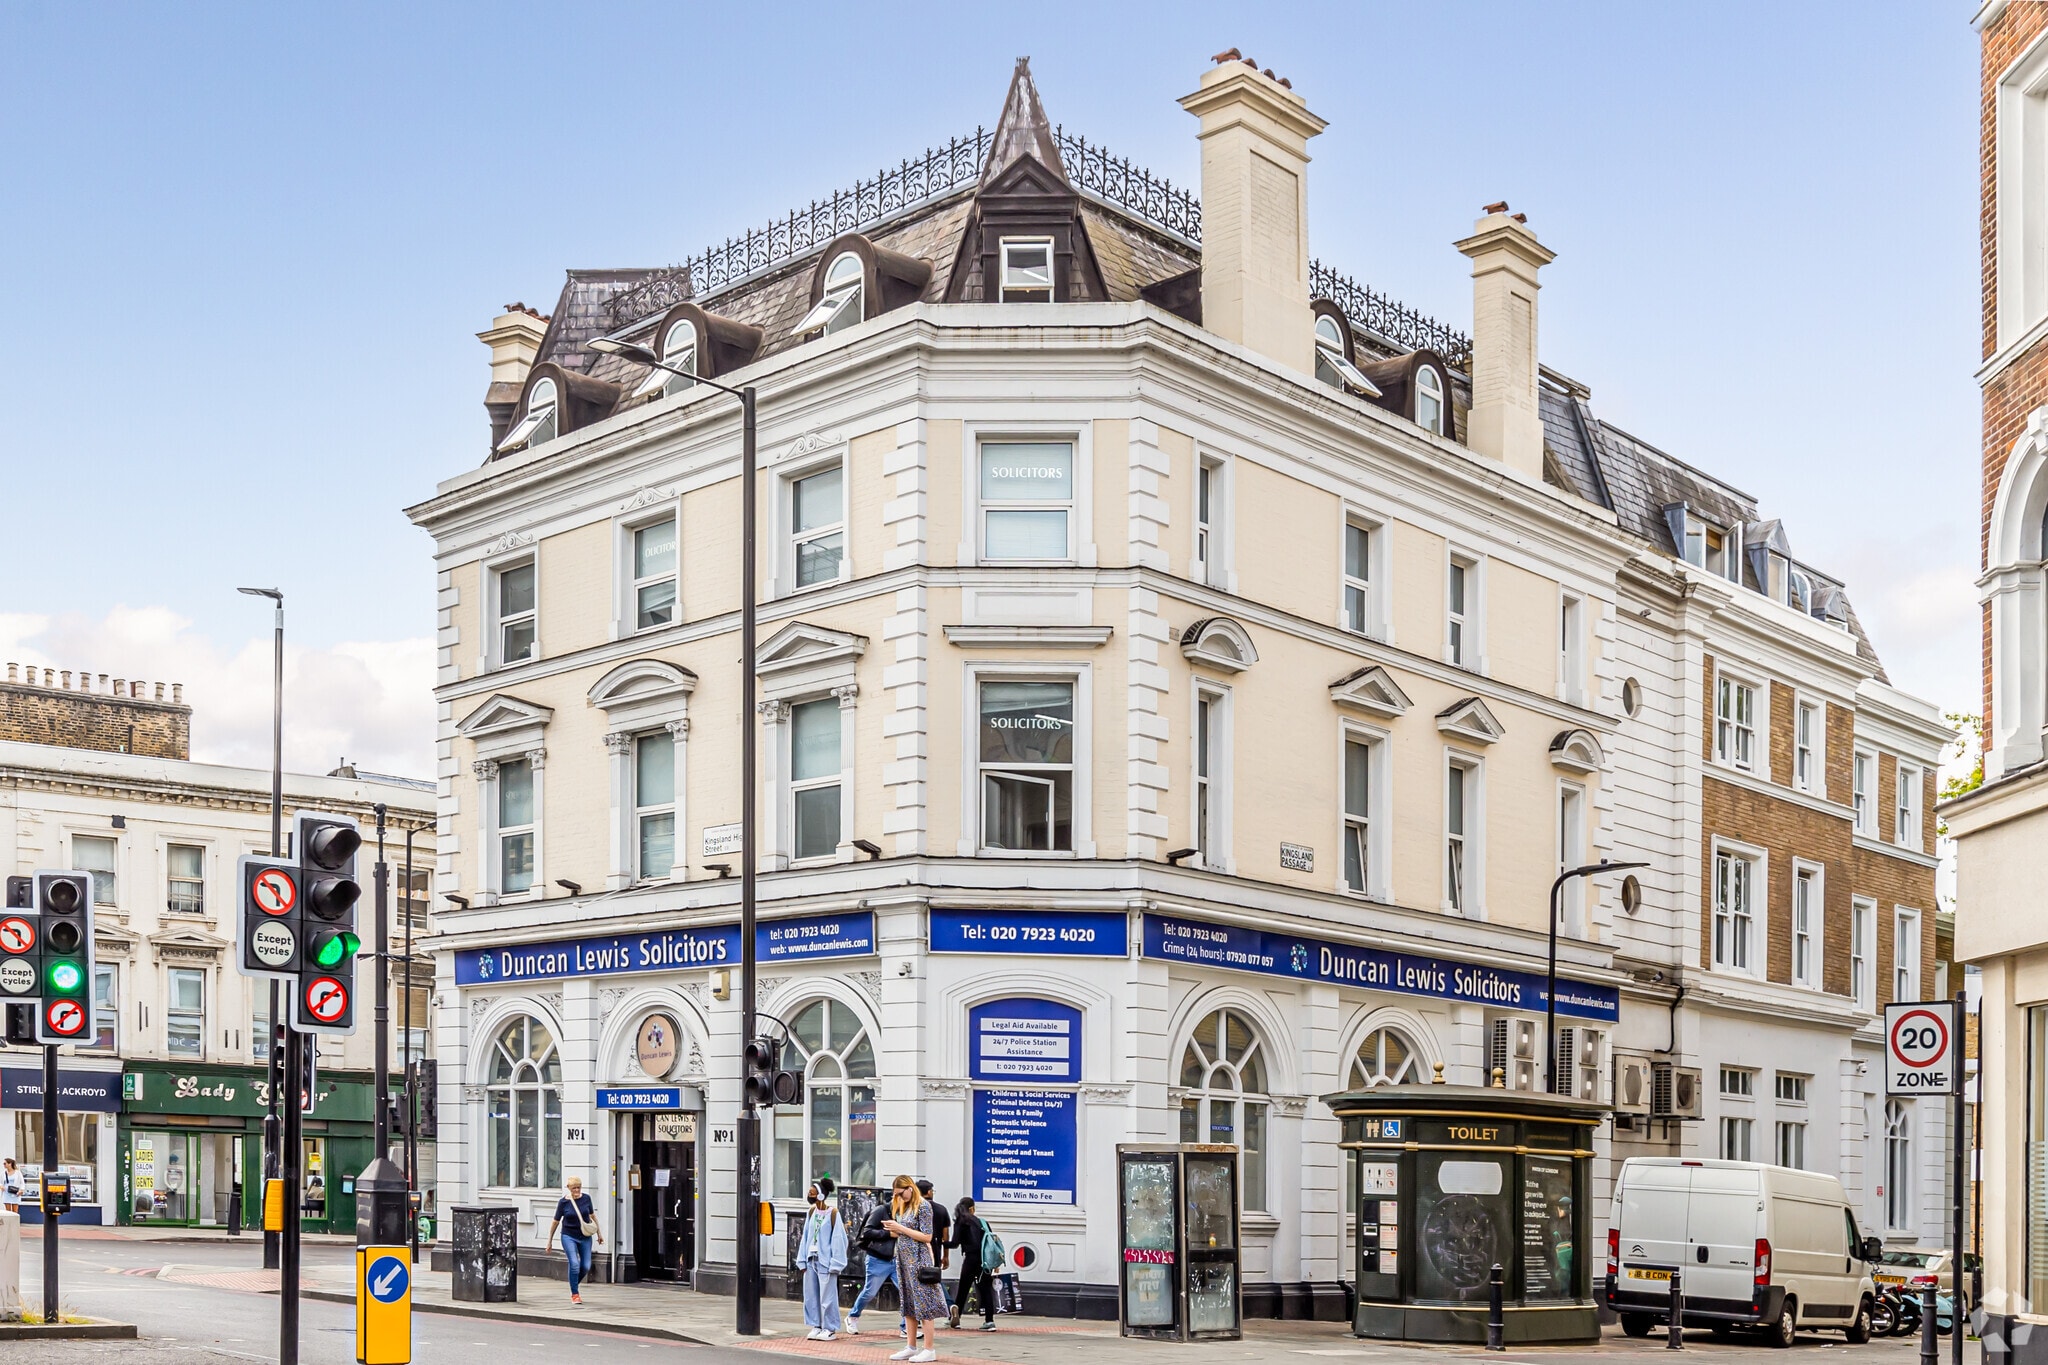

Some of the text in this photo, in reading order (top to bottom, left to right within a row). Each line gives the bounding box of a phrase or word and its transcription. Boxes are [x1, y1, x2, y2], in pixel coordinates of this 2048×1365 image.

[992, 467, 1062, 478] SOLICITORS
[991, 718, 1062, 730] SOLICITORS
[1281, 848, 1313, 862] KINGSLAND
[1282, 857, 1306, 870] PASSAGE
[770, 924, 839, 940] tel: 020 7923 4020
[961, 925, 1095, 941] Tel: 020 7923 4020
[1163, 923, 1227, 943] Tel: 020 7923 4020
[257, 933, 291, 945] Except
[258, 946, 289, 956] cycles
[770, 938, 868, 954] web: www.duncanlewis.com
[502, 934, 726, 977] Duncan Lewis Solicitors
[1163, 941, 1274, 967] Crime (24 hours): 07920 077 057
[2, 968, 32, 977] Except
[1320, 947, 1521, 1003] Duncan Lewis Solicitors
[3, 977, 31, 986] cycles
[1554, 994, 1615, 1010] www.duncanlewis.com
[1902, 1028, 1936, 1049] 20
[659, 1051, 672, 1059] Lewis
[1897, 1073, 1944, 1087] ZONE
[17, 1086, 106, 1096] STIRL ACKROYD
[175, 1076, 235, 1101] Lady
[607, 1094, 669, 1104] Tel: 020 7923 4020
[658, 1125, 692, 1133] SOLICITORS
[1448, 1127, 1498, 1140] TOILET
